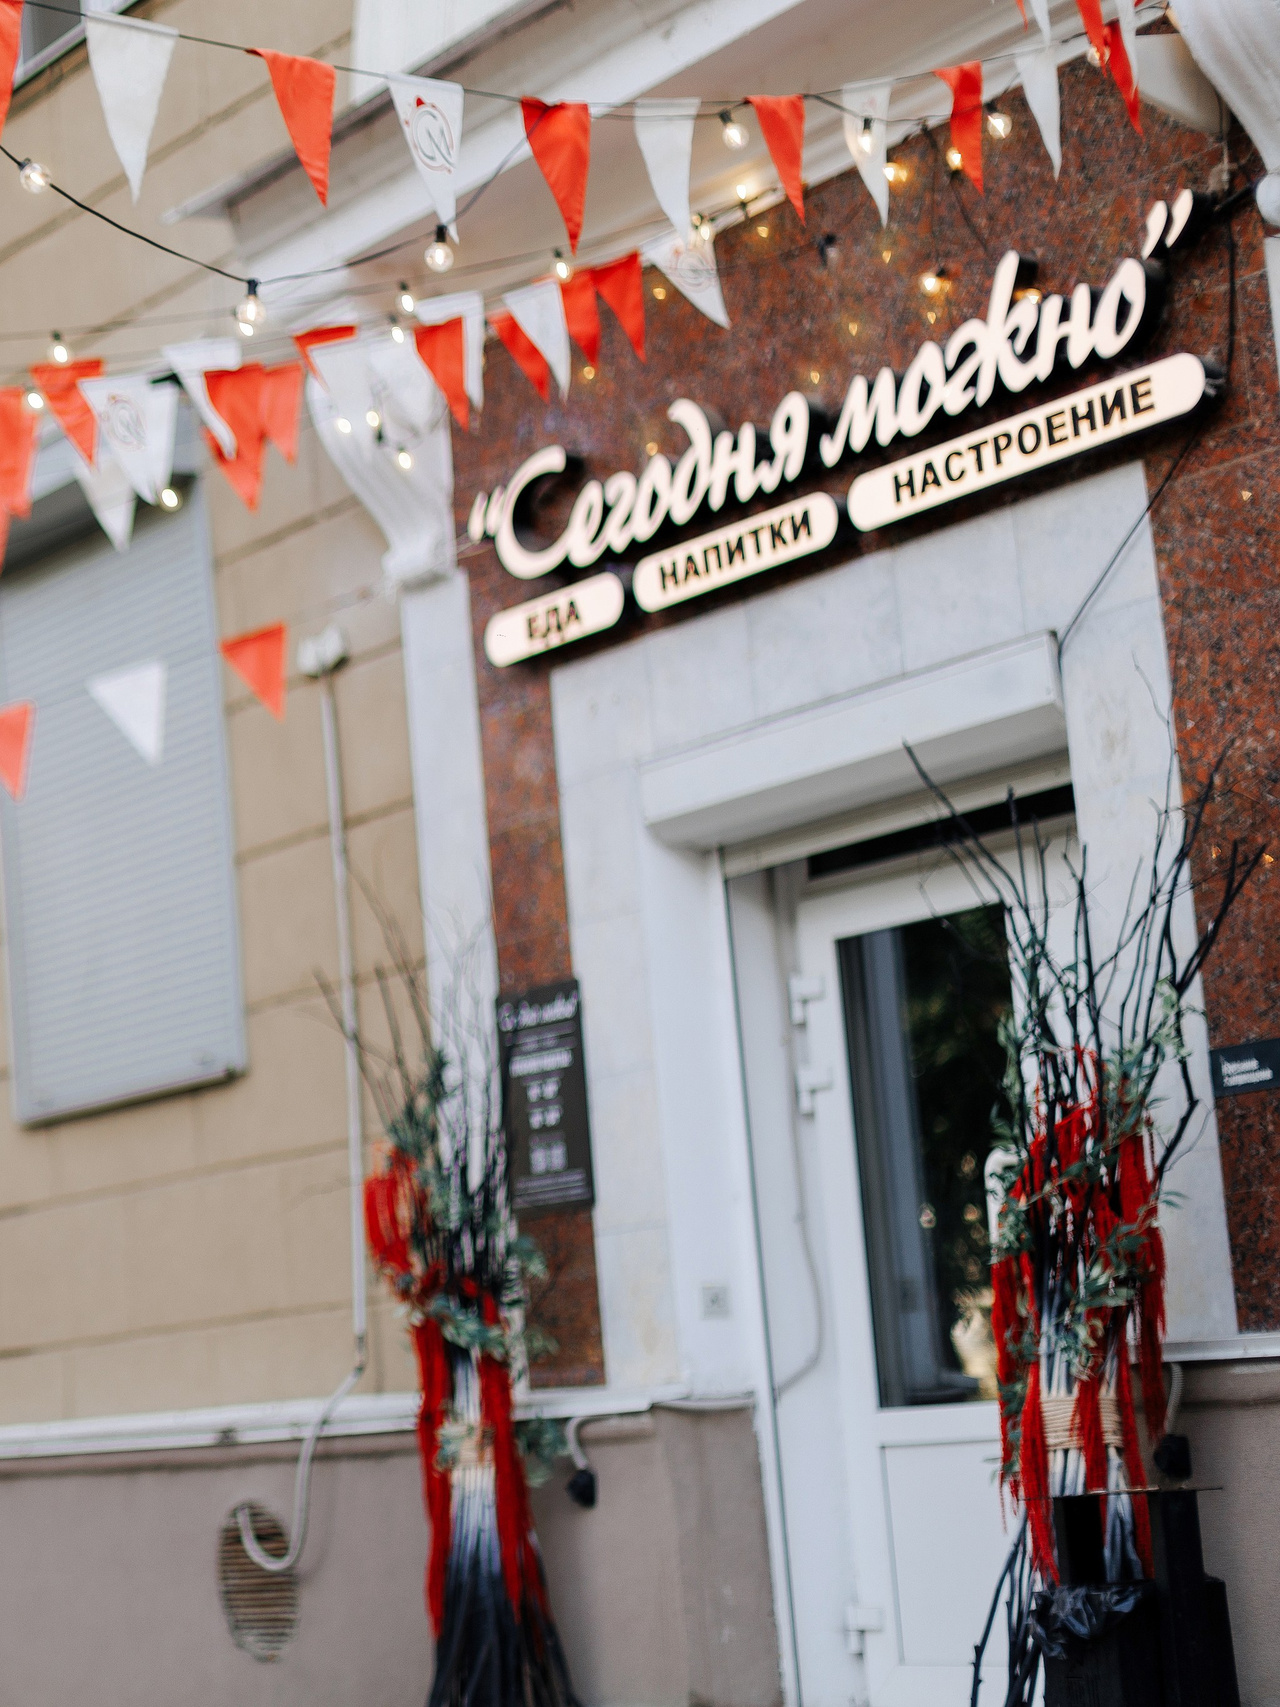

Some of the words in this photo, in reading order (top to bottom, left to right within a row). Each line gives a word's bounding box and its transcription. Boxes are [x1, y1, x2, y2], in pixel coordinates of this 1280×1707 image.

[892, 376, 1156, 503] НАСТРОЕНИЕ
[659, 510, 813, 591] НАПИТКИ
[526, 600, 582, 648] ЕДА
